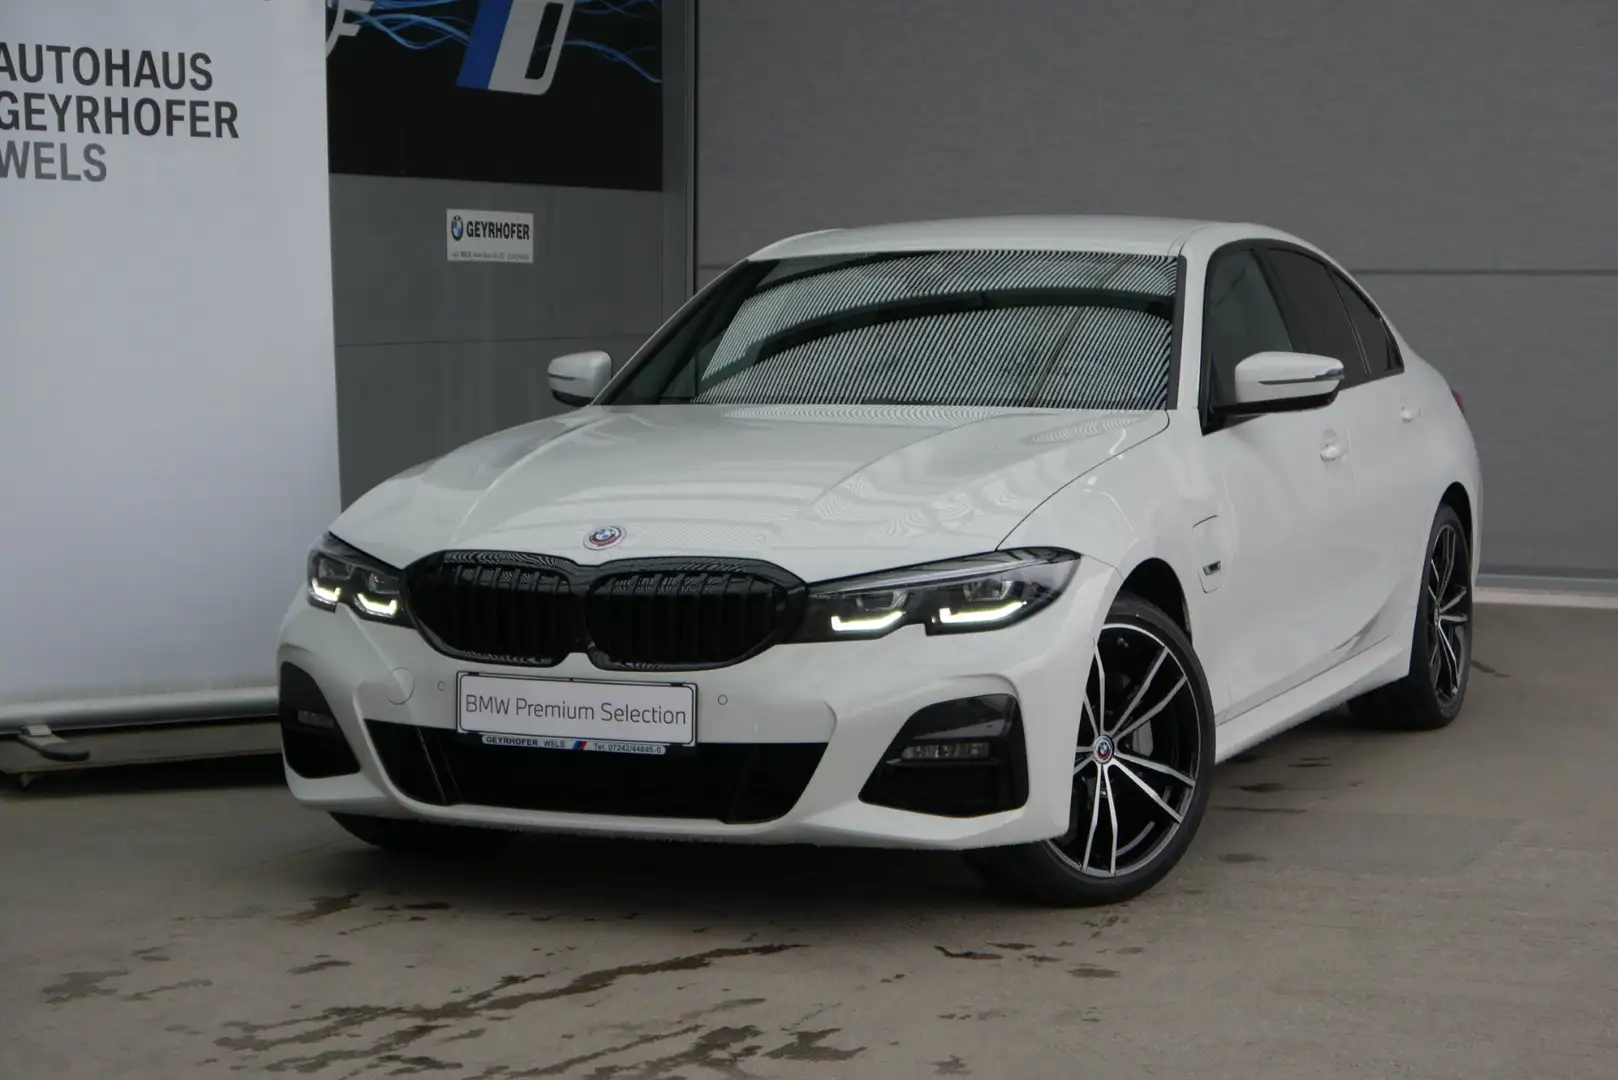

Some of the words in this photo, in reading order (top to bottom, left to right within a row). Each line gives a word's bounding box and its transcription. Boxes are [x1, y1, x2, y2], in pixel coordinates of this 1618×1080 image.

[0, 42, 213, 91] AUTOHAUS
[0, 91, 239, 139] GEYRHOFER
[0, 140, 107, 182] WELS
[466, 220, 530, 240] GEYRHOFER
[465, 694, 511, 716] BMW
[516, 698, 595, 720] Premium
[601, 703, 687, 725] Selection
[486, 735, 538, 746] GEYRHOFER
[543, 740, 566, 748] WELS
